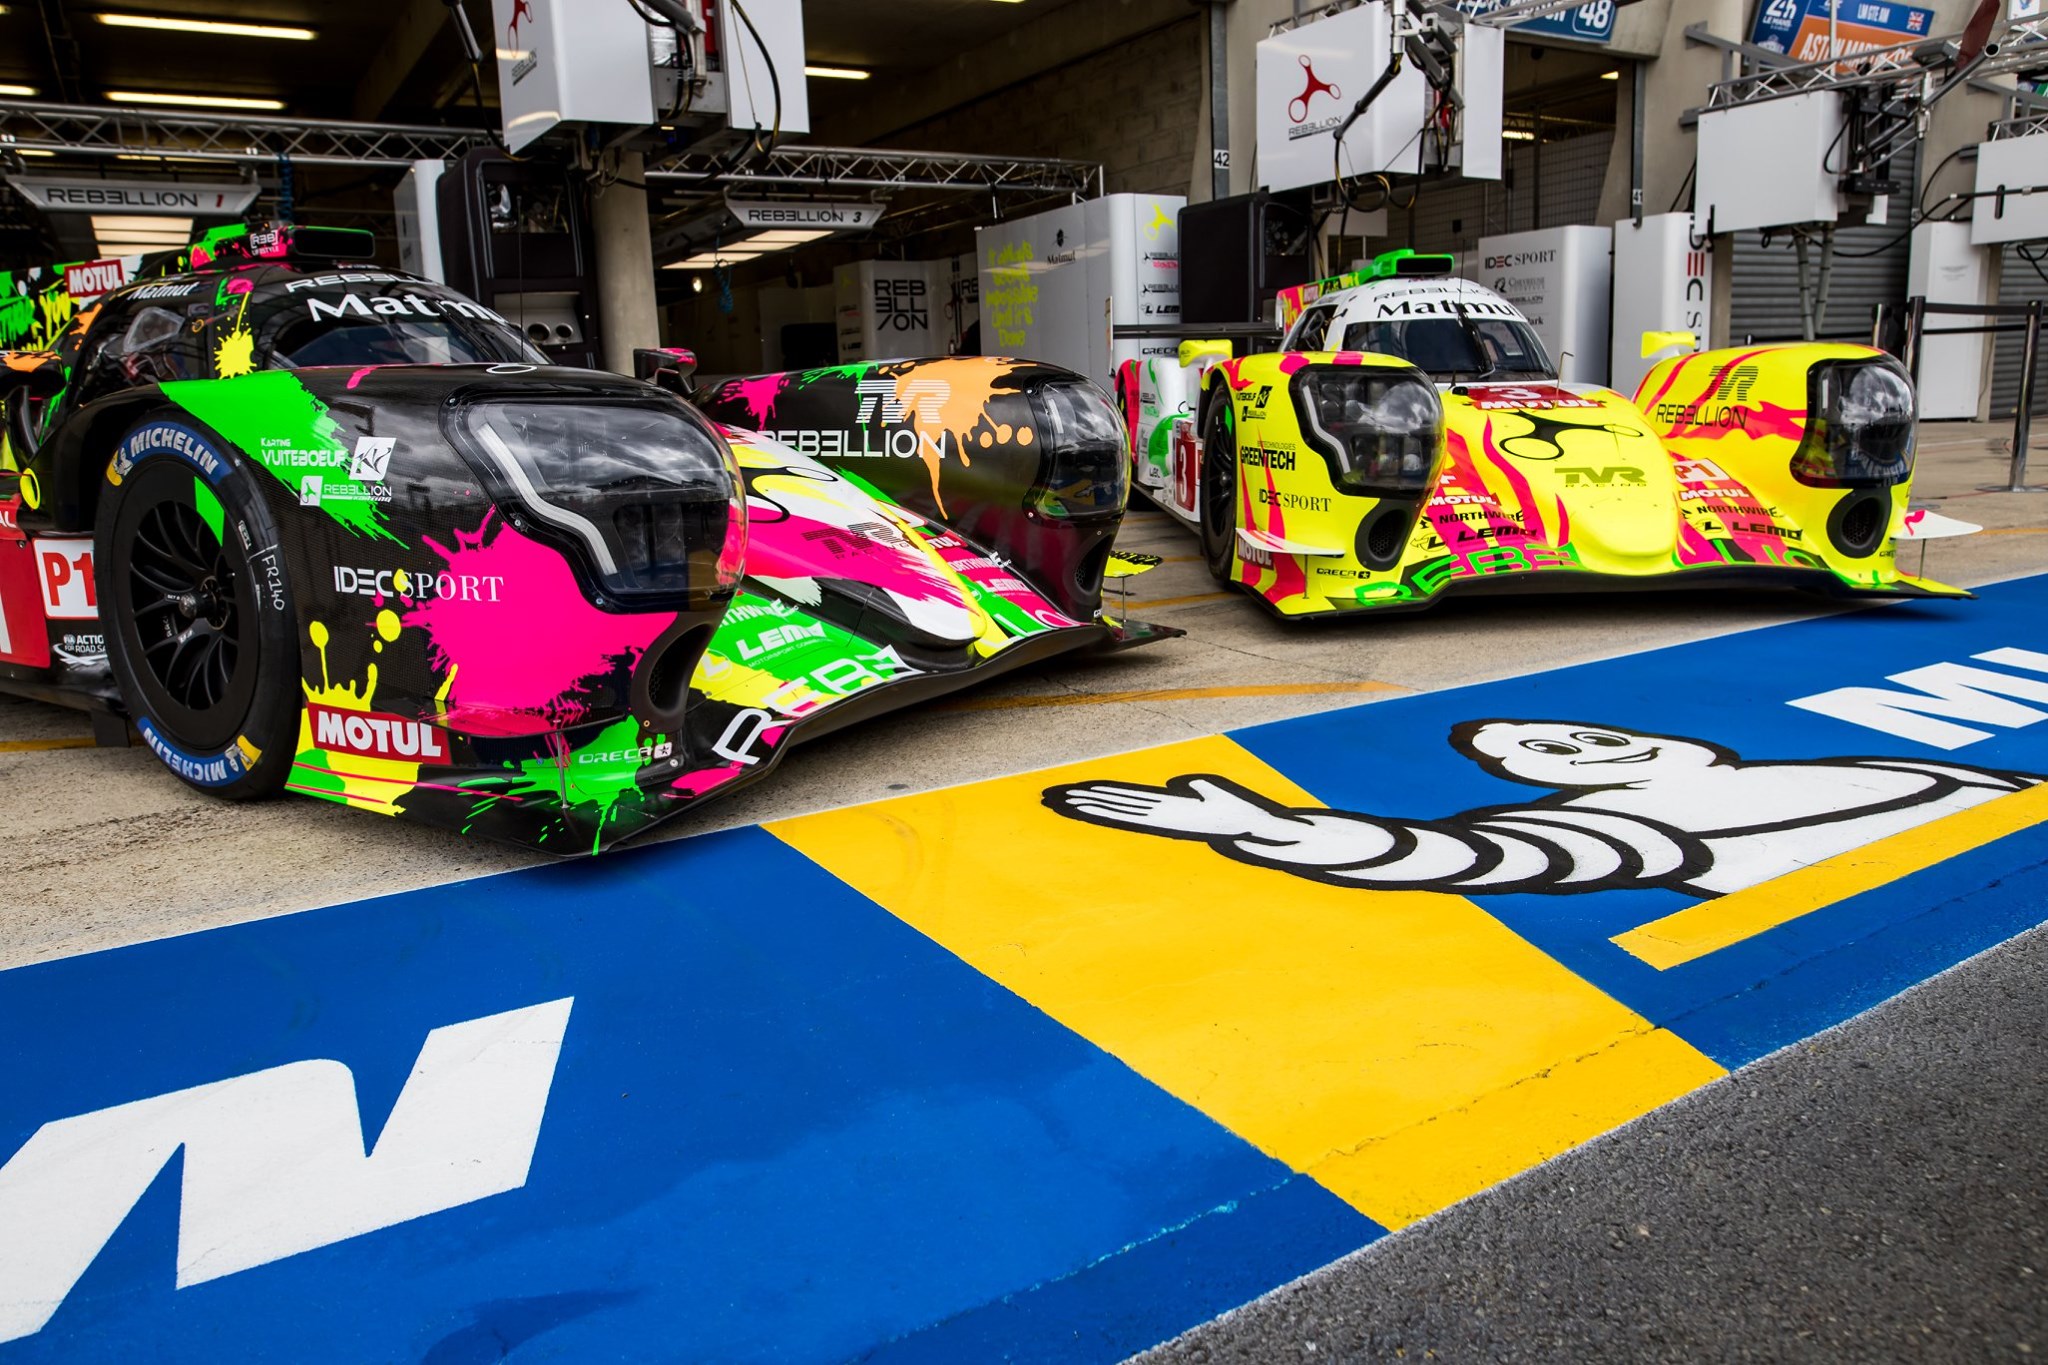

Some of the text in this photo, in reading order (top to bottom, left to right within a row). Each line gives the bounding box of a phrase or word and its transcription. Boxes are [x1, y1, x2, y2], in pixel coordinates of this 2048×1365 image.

[1579, 0, 1609, 28] 48
[1215, 152, 1229, 166] 42
[47, 188, 198, 207] REBELLION
[749, 209, 861, 223] REBELLION 3
[1485, 250, 1556, 269] IDEC SPORT
[68, 264, 124, 294] MOTUL
[874, 279, 926, 296] REB
[127, 282, 200, 300] Matmut
[1487, 386, 1541, 399] 3
[1655, 403, 1748, 429] REBELLION
[130, 426, 219, 476] MICHELIN
[262, 449, 347, 468] VUITEBOEUF
[1555, 467, 1648, 484] TVR
[324, 484, 392, 497] REBELLION
[1259, 488, 1332, 512] IDEC SPORT
[1680, 489, 1750, 500] MOTUL
[1429, 495, 1497, 506] MOTUL
[1439, 510, 1524, 524] NORTHWIRE
[1696, 506, 1778, 518] NORTHWIRE
[42, 552, 97, 607] P1
[1316, 568, 1357, 577] ORECA
[334, 566, 504, 602] IDEC SPORT
[317, 710, 442, 757] MOTUL
[144, 727, 227, 781] MICHELIN
[578, 746, 653, 765] ORECA
